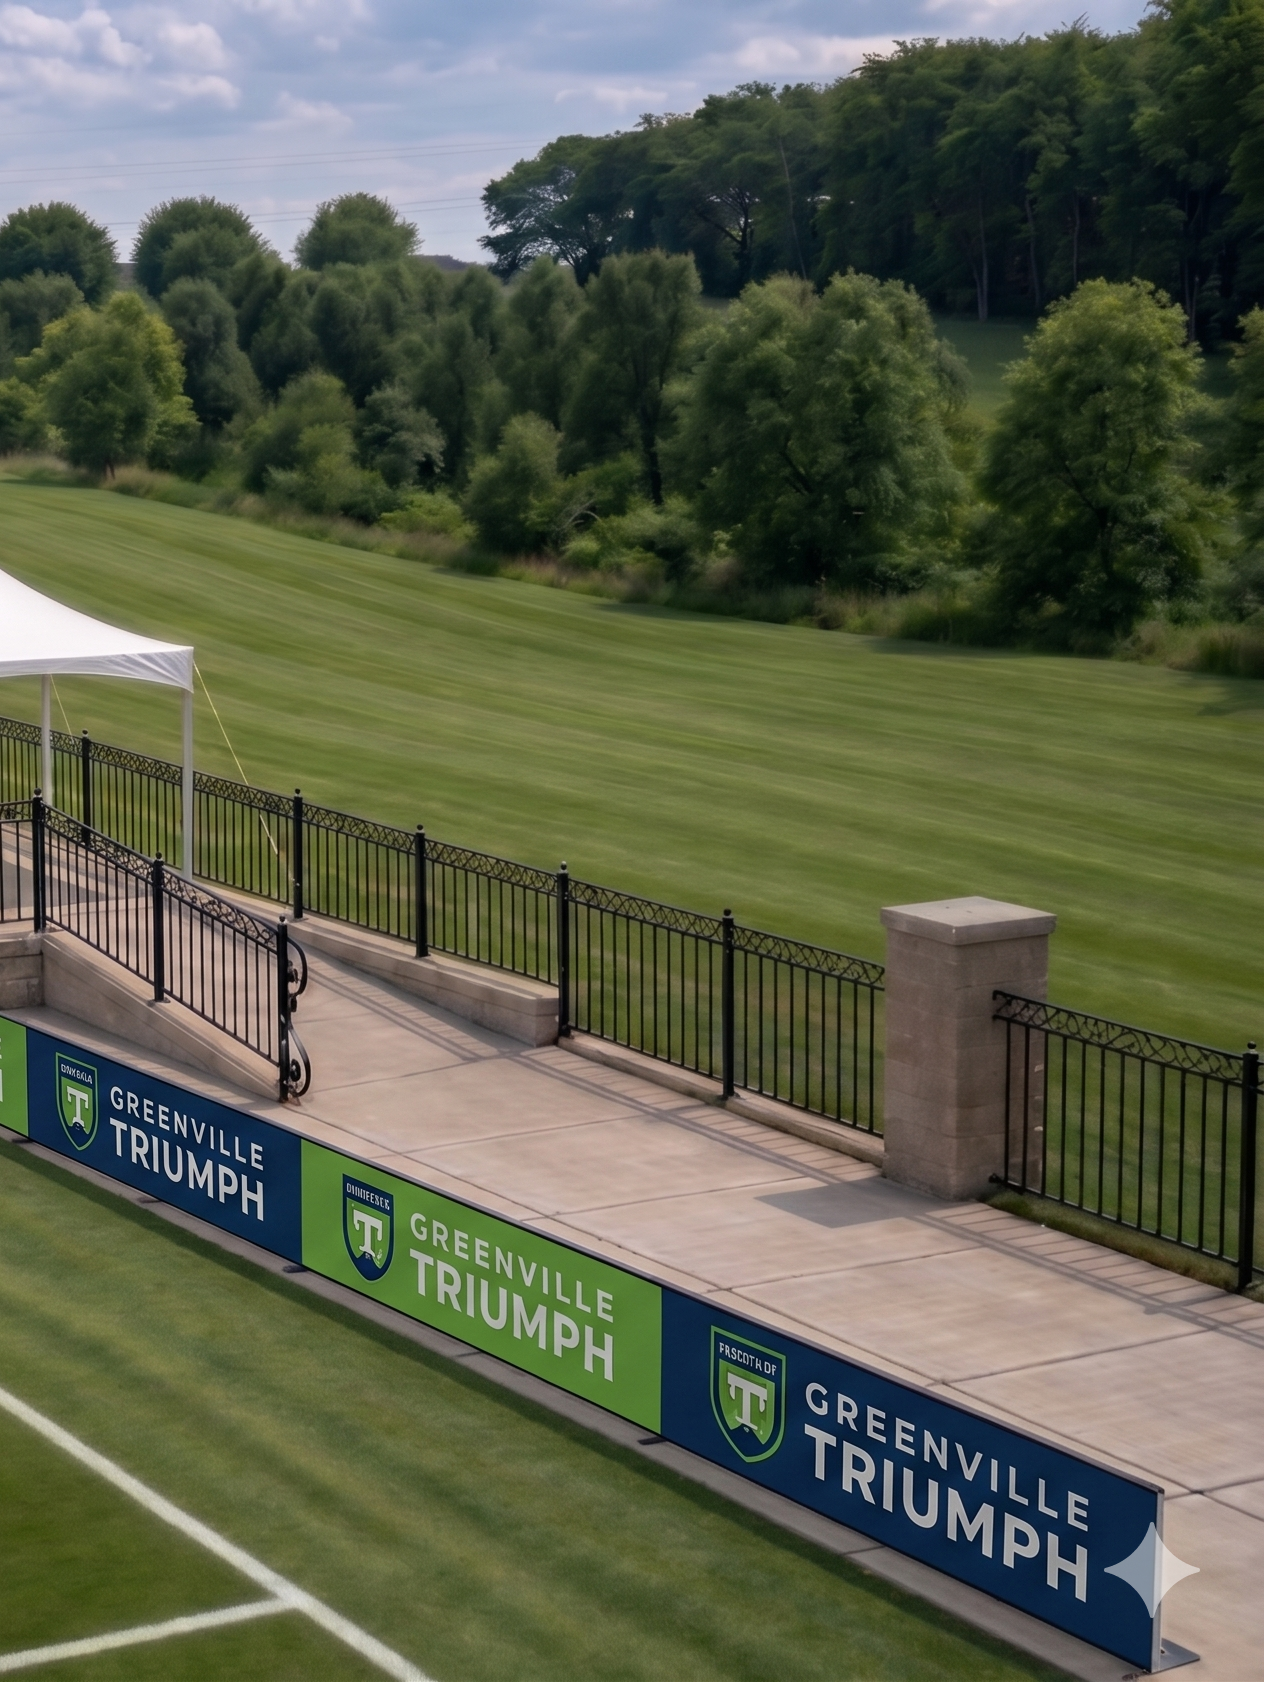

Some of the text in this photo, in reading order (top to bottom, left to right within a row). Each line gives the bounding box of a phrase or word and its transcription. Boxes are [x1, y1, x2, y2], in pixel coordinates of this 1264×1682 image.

[109, 1117, 264, 1222] TRIUMPH
[110, 1086, 264, 1171] GREENVILLE
[409, 1248, 614, 1383] TRIUMPH
[410, 1212, 614, 1324] GREENVILLE
[804, 1382, 1090, 1533] GREENVILLE
[804, 1423, 1088, 1604] TRIUMPH
